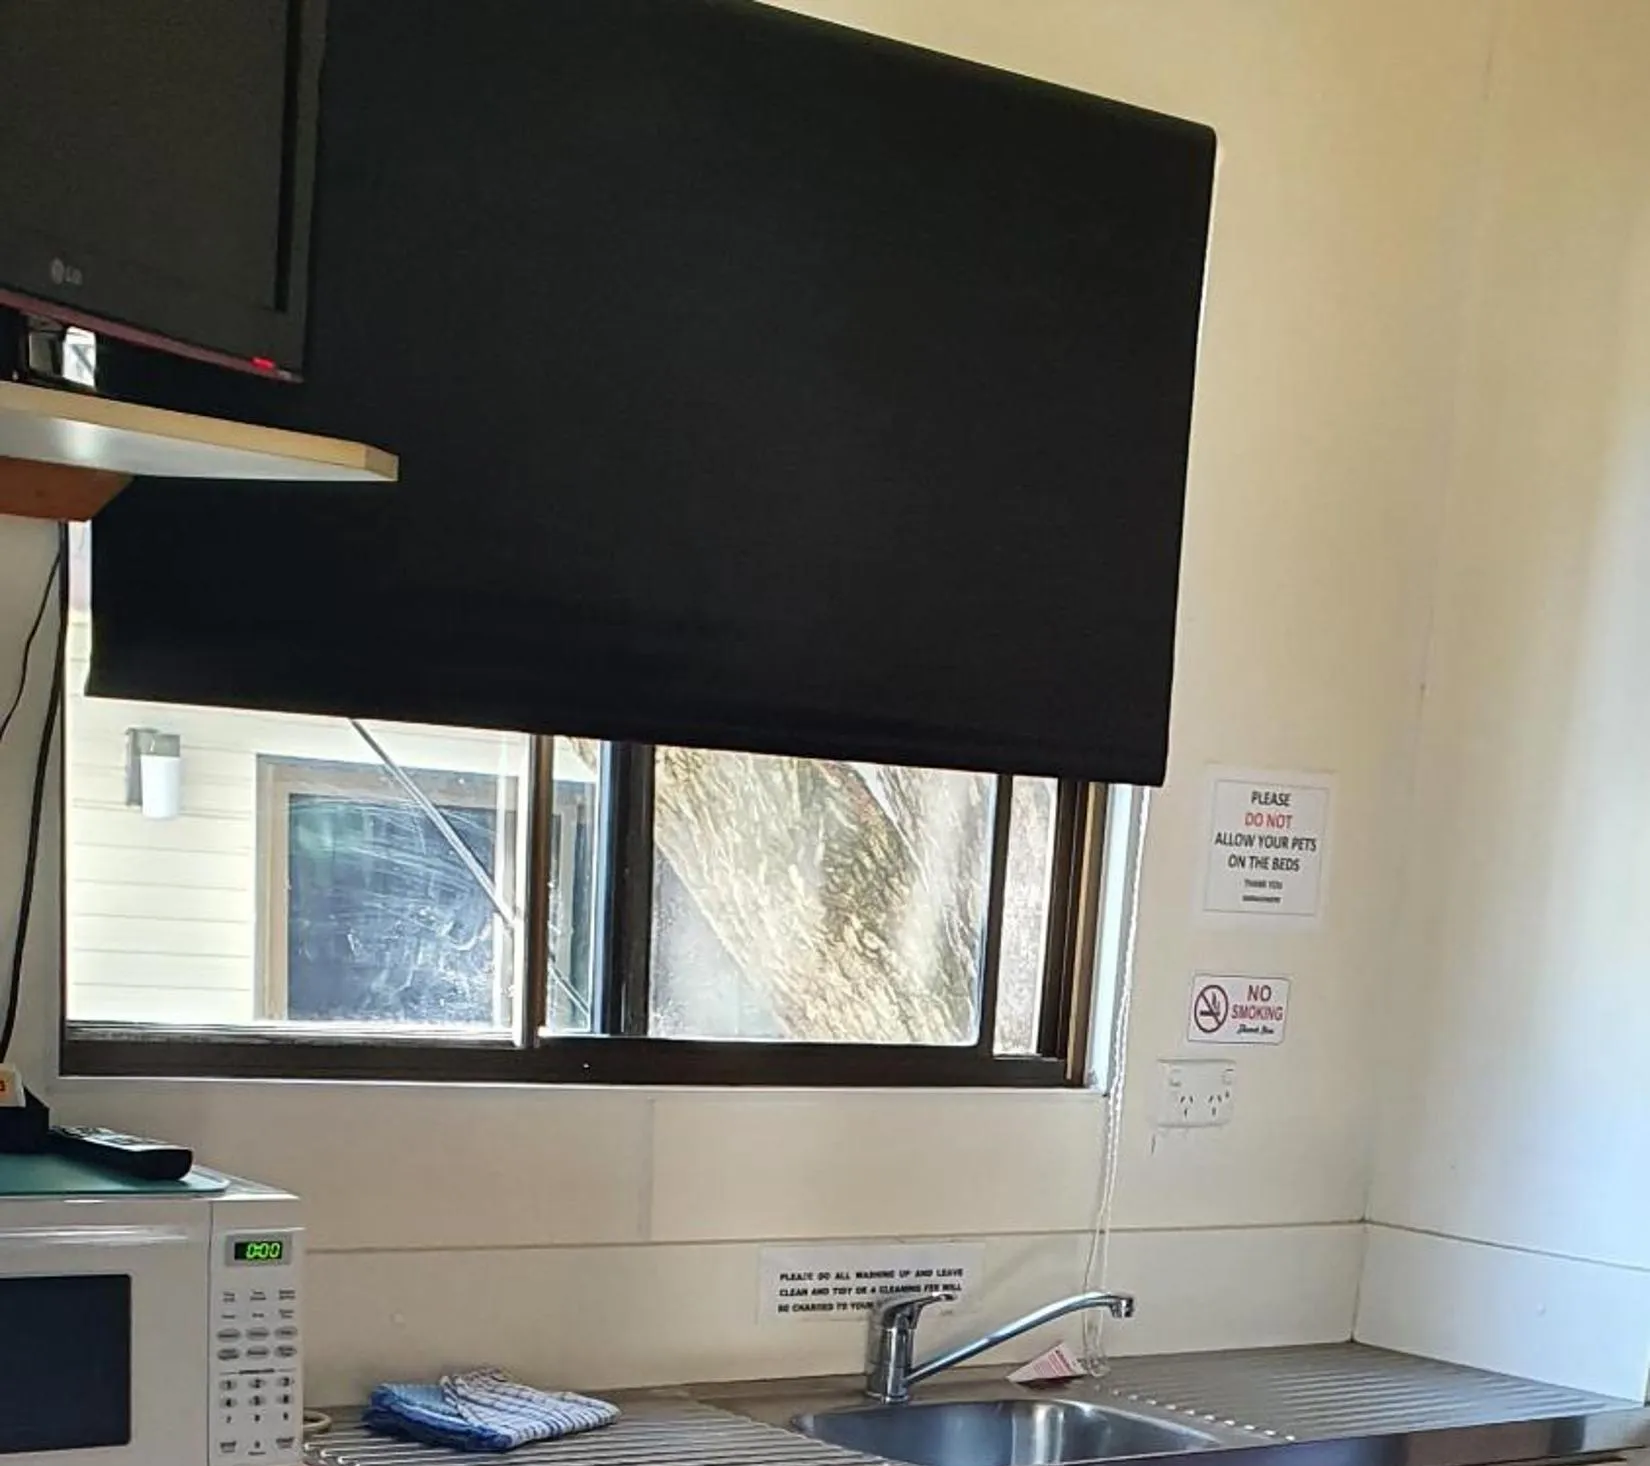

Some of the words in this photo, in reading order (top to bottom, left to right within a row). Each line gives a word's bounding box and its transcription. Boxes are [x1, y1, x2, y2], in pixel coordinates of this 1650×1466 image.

[1251, 791, 1291, 806] PLEASE
[1245, 812, 1263, 826] DO
[1266, 814, 1293, 828] NOT
[1215, 832, 1255, 847] ALLOW
[1258, 835, 1288, 849] YOUR
[1292, 838, 1316, 852] PETS
[1228, 854, 1245, 868] ON
[1249, 856, 1270, 870] THE
[1272, 858, 1300, 872] BEDS
[1247, 985, 1271, 1002] NO
[1231, 1004, 1283, 1021] SMOKING
[246, 1242, 280, 1258] 0:00
[779, 1272, 813, 1281] PLEASE
[818, 1272, 831, 1280] DO
[936, 1268, 963, 1277] LEAVE
[779, 1288, 808, 1296] CLEAN
[811, 1288, 829, 1296] AND
[879, 1285, 921, 1294] CLEANING
